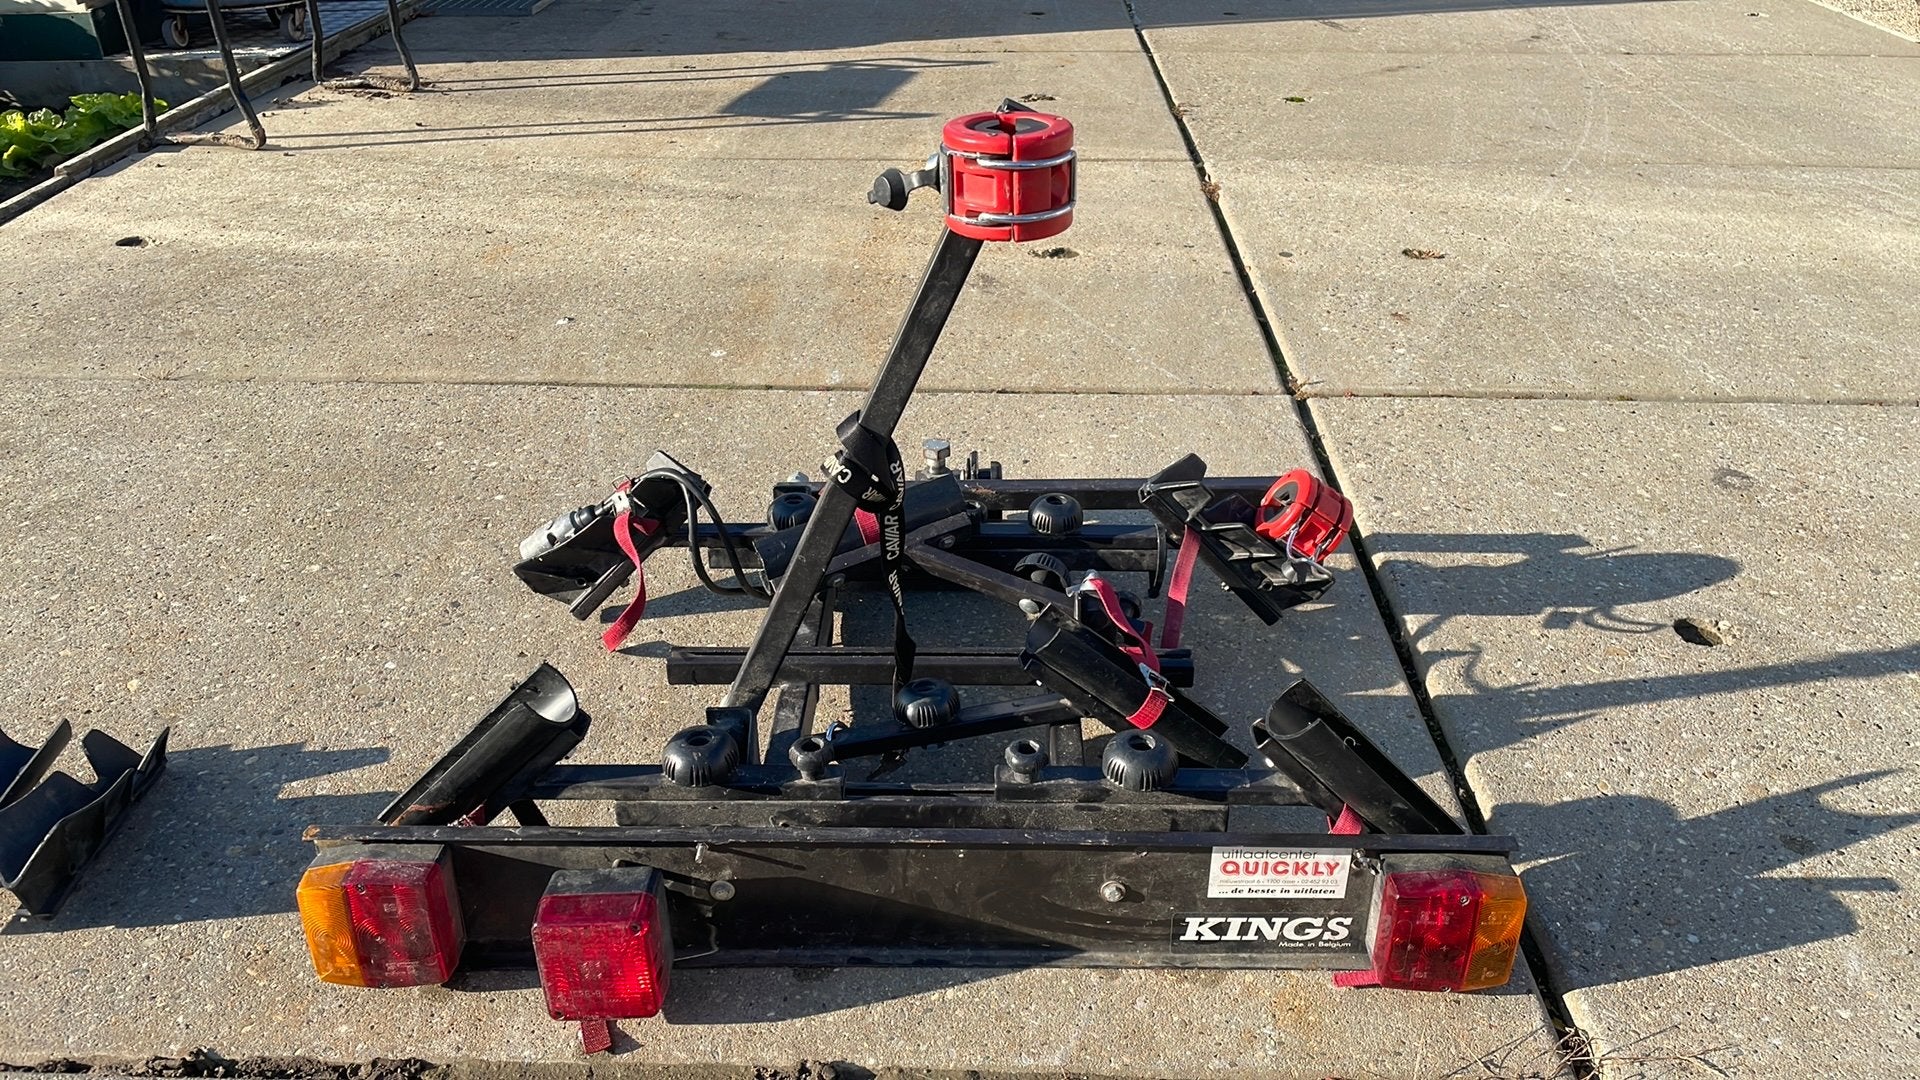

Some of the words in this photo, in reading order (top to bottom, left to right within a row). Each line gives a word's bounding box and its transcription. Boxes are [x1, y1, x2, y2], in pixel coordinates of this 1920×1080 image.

[884, 515, 900, 560] CAVIAR
[1222, 849, 1317, 860] uitlaatcenter
[1220, 860, 1340, 877] QUICKLY
[1294, 887, 1336, 895] uitlaten
[1179, 917, 1353, 941] KINGS
